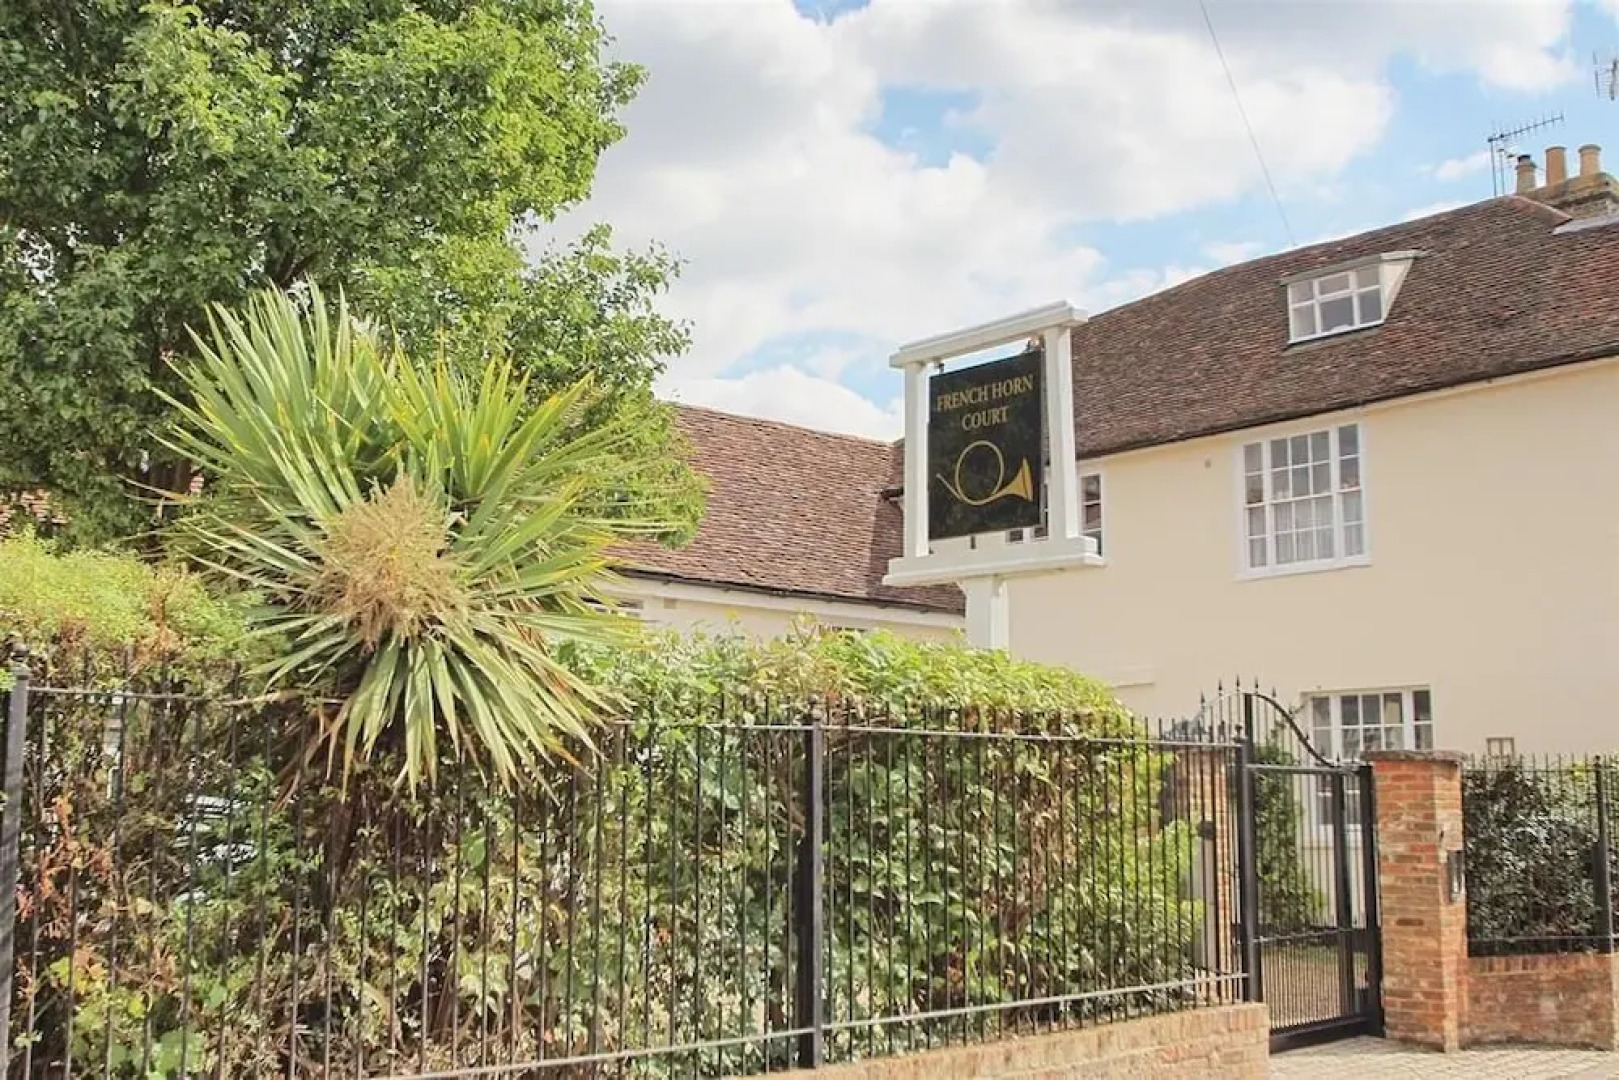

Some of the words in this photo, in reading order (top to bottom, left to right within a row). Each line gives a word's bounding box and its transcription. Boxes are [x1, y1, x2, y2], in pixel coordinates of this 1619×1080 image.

[937, 385, 988, 412] FRENCH
[991, 374, 1034, 399] HORN
[961, 406, 1009, 431] COURT
